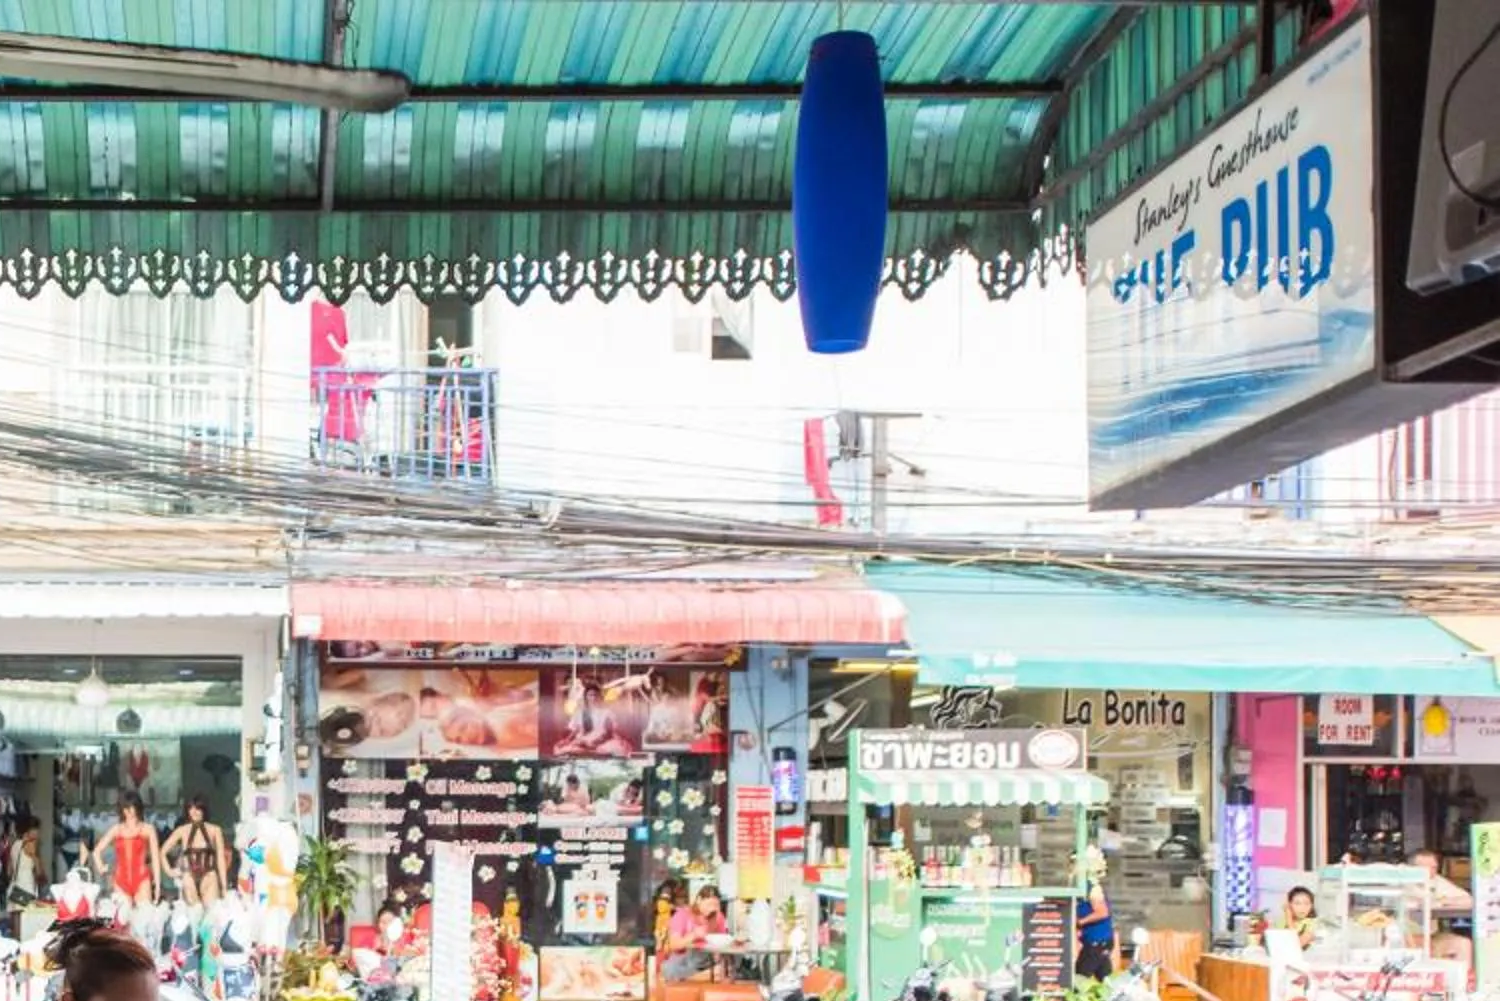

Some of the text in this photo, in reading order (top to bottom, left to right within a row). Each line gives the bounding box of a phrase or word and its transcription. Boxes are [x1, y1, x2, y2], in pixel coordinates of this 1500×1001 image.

[1134, 107, 1299, 245] Stanley's Guesthouse
[1220, 144, 1335, 299] PUB
[1062, 689, 1187, 728] La Bonita
[1333, 698, 1363, 715] ROOM
[1319, 724, 1372, 741] FOR RENT
[861, 740, 1022, 771] ชาพะยอม
